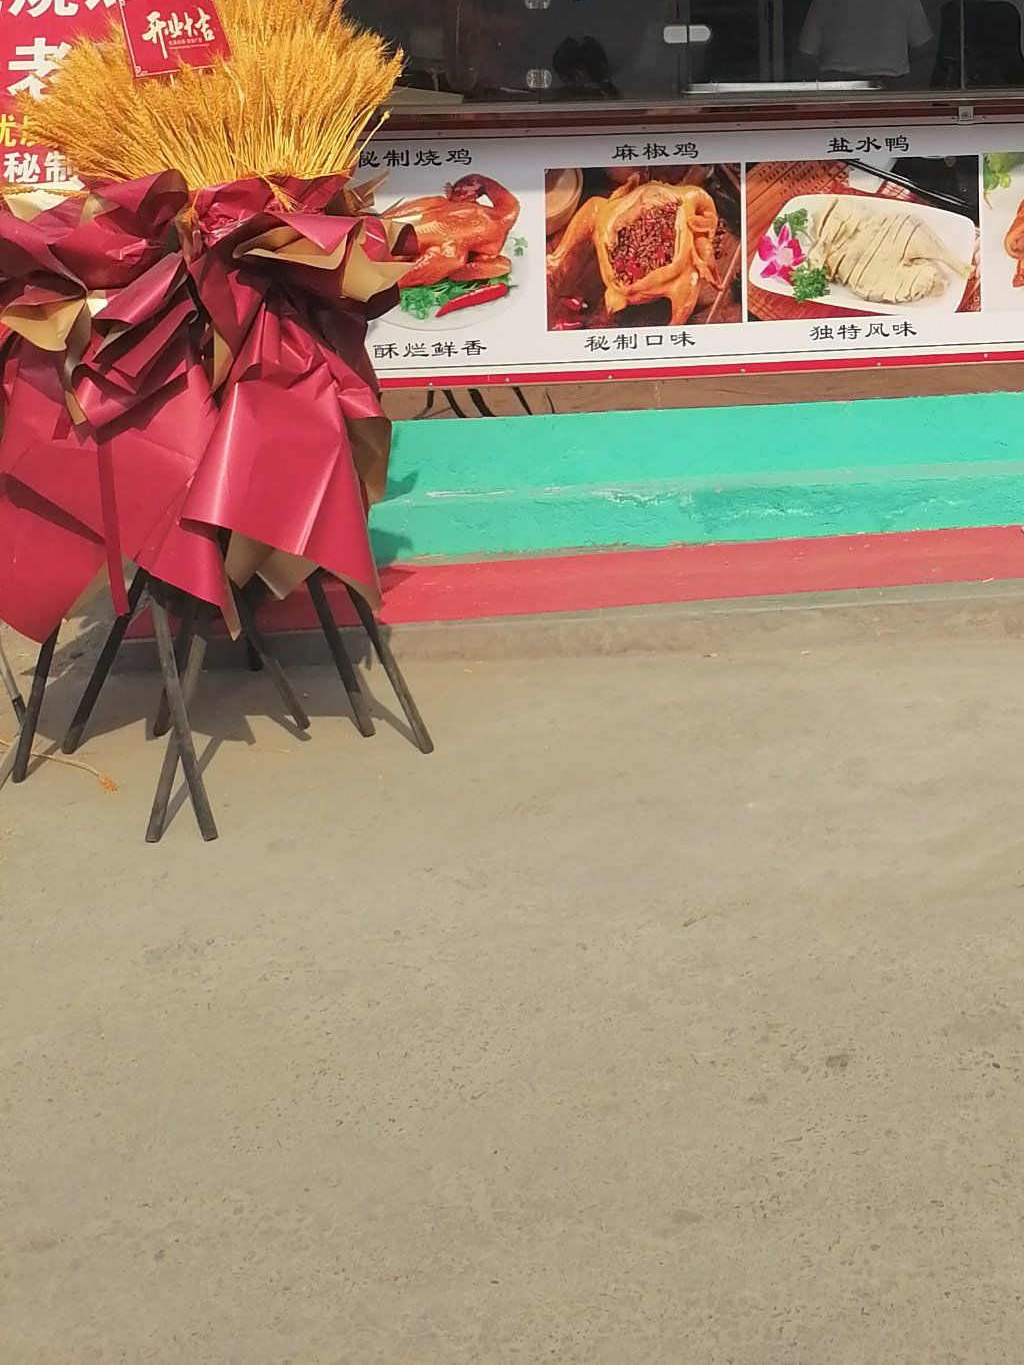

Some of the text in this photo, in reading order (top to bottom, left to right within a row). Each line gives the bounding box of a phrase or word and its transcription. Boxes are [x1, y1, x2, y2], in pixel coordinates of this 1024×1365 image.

[141, 7, 215, 59] 开业大吉
[612, 142, 699, 160] 麻椒鸡
[828, 135, 910, 154] 盐水鸭
[358, 148, 472, 168] 秘制烧鸡
[810, 322, 918, 341] 独特风味
[373, 339, 488, 358] 酥烂鲜香
[584, 332, 697, 353] 秘制口味
